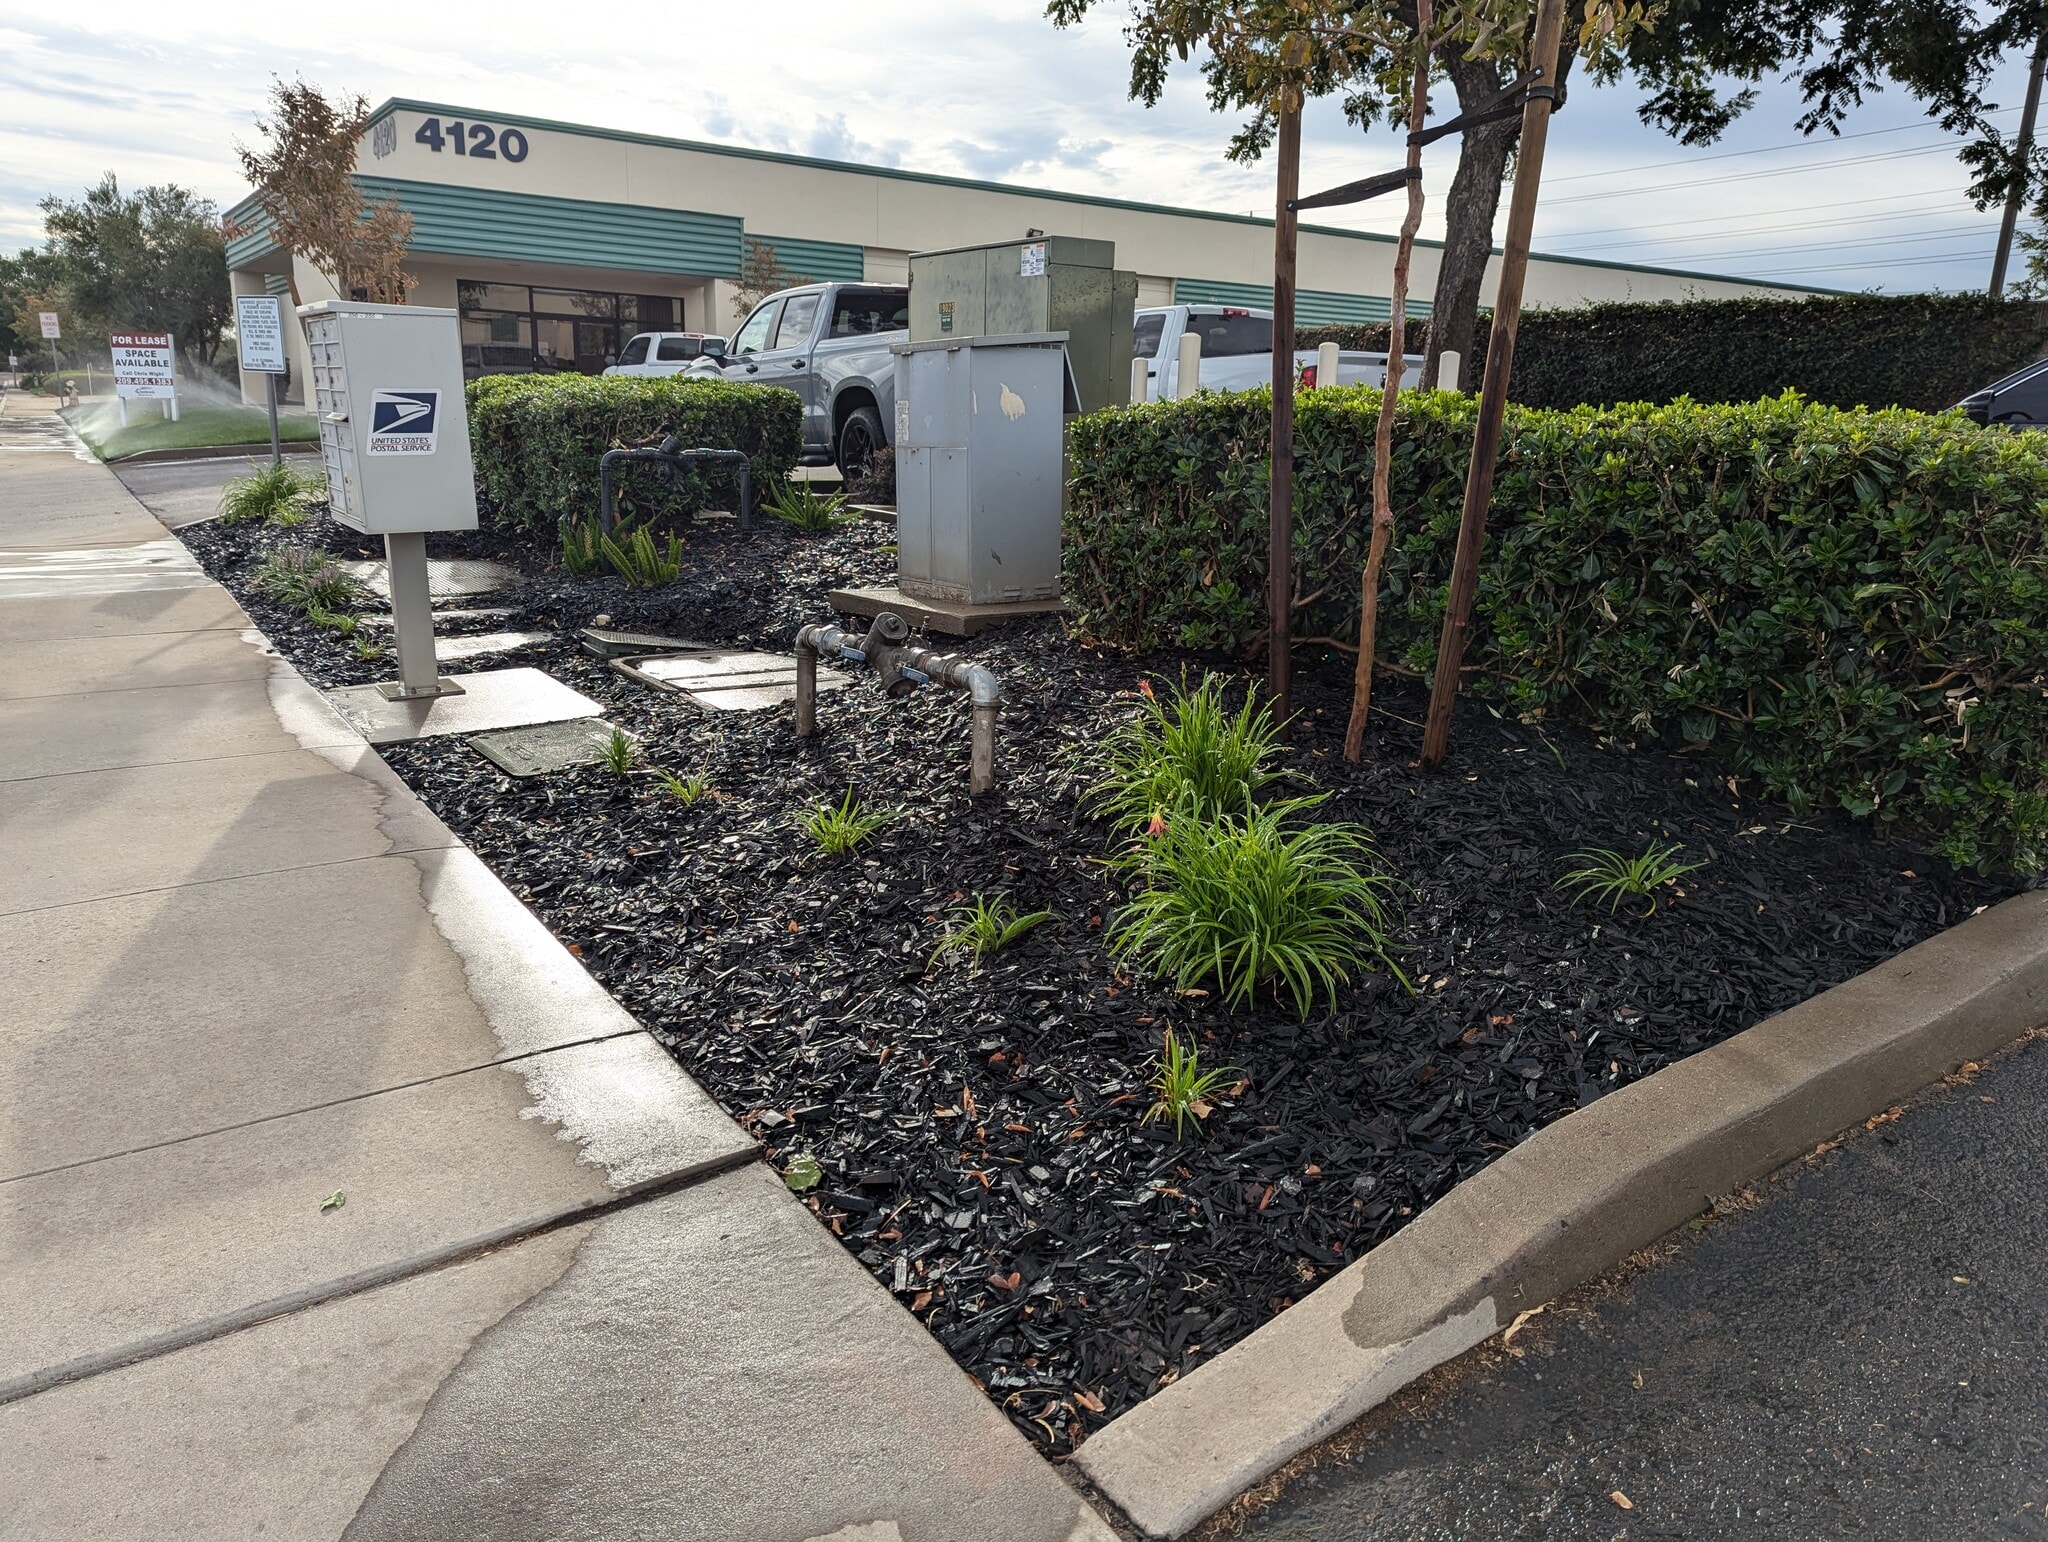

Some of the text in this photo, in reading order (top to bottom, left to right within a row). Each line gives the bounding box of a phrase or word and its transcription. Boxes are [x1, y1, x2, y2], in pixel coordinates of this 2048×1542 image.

[373, 116, 397, 160] 4120
[415, 118, 528, 163] 4120
[112, 336, 167, 345] FOR LEASE
[125, 350, 157, 358] SPACE
[115, 359, 169, 367] AVAILABLE
